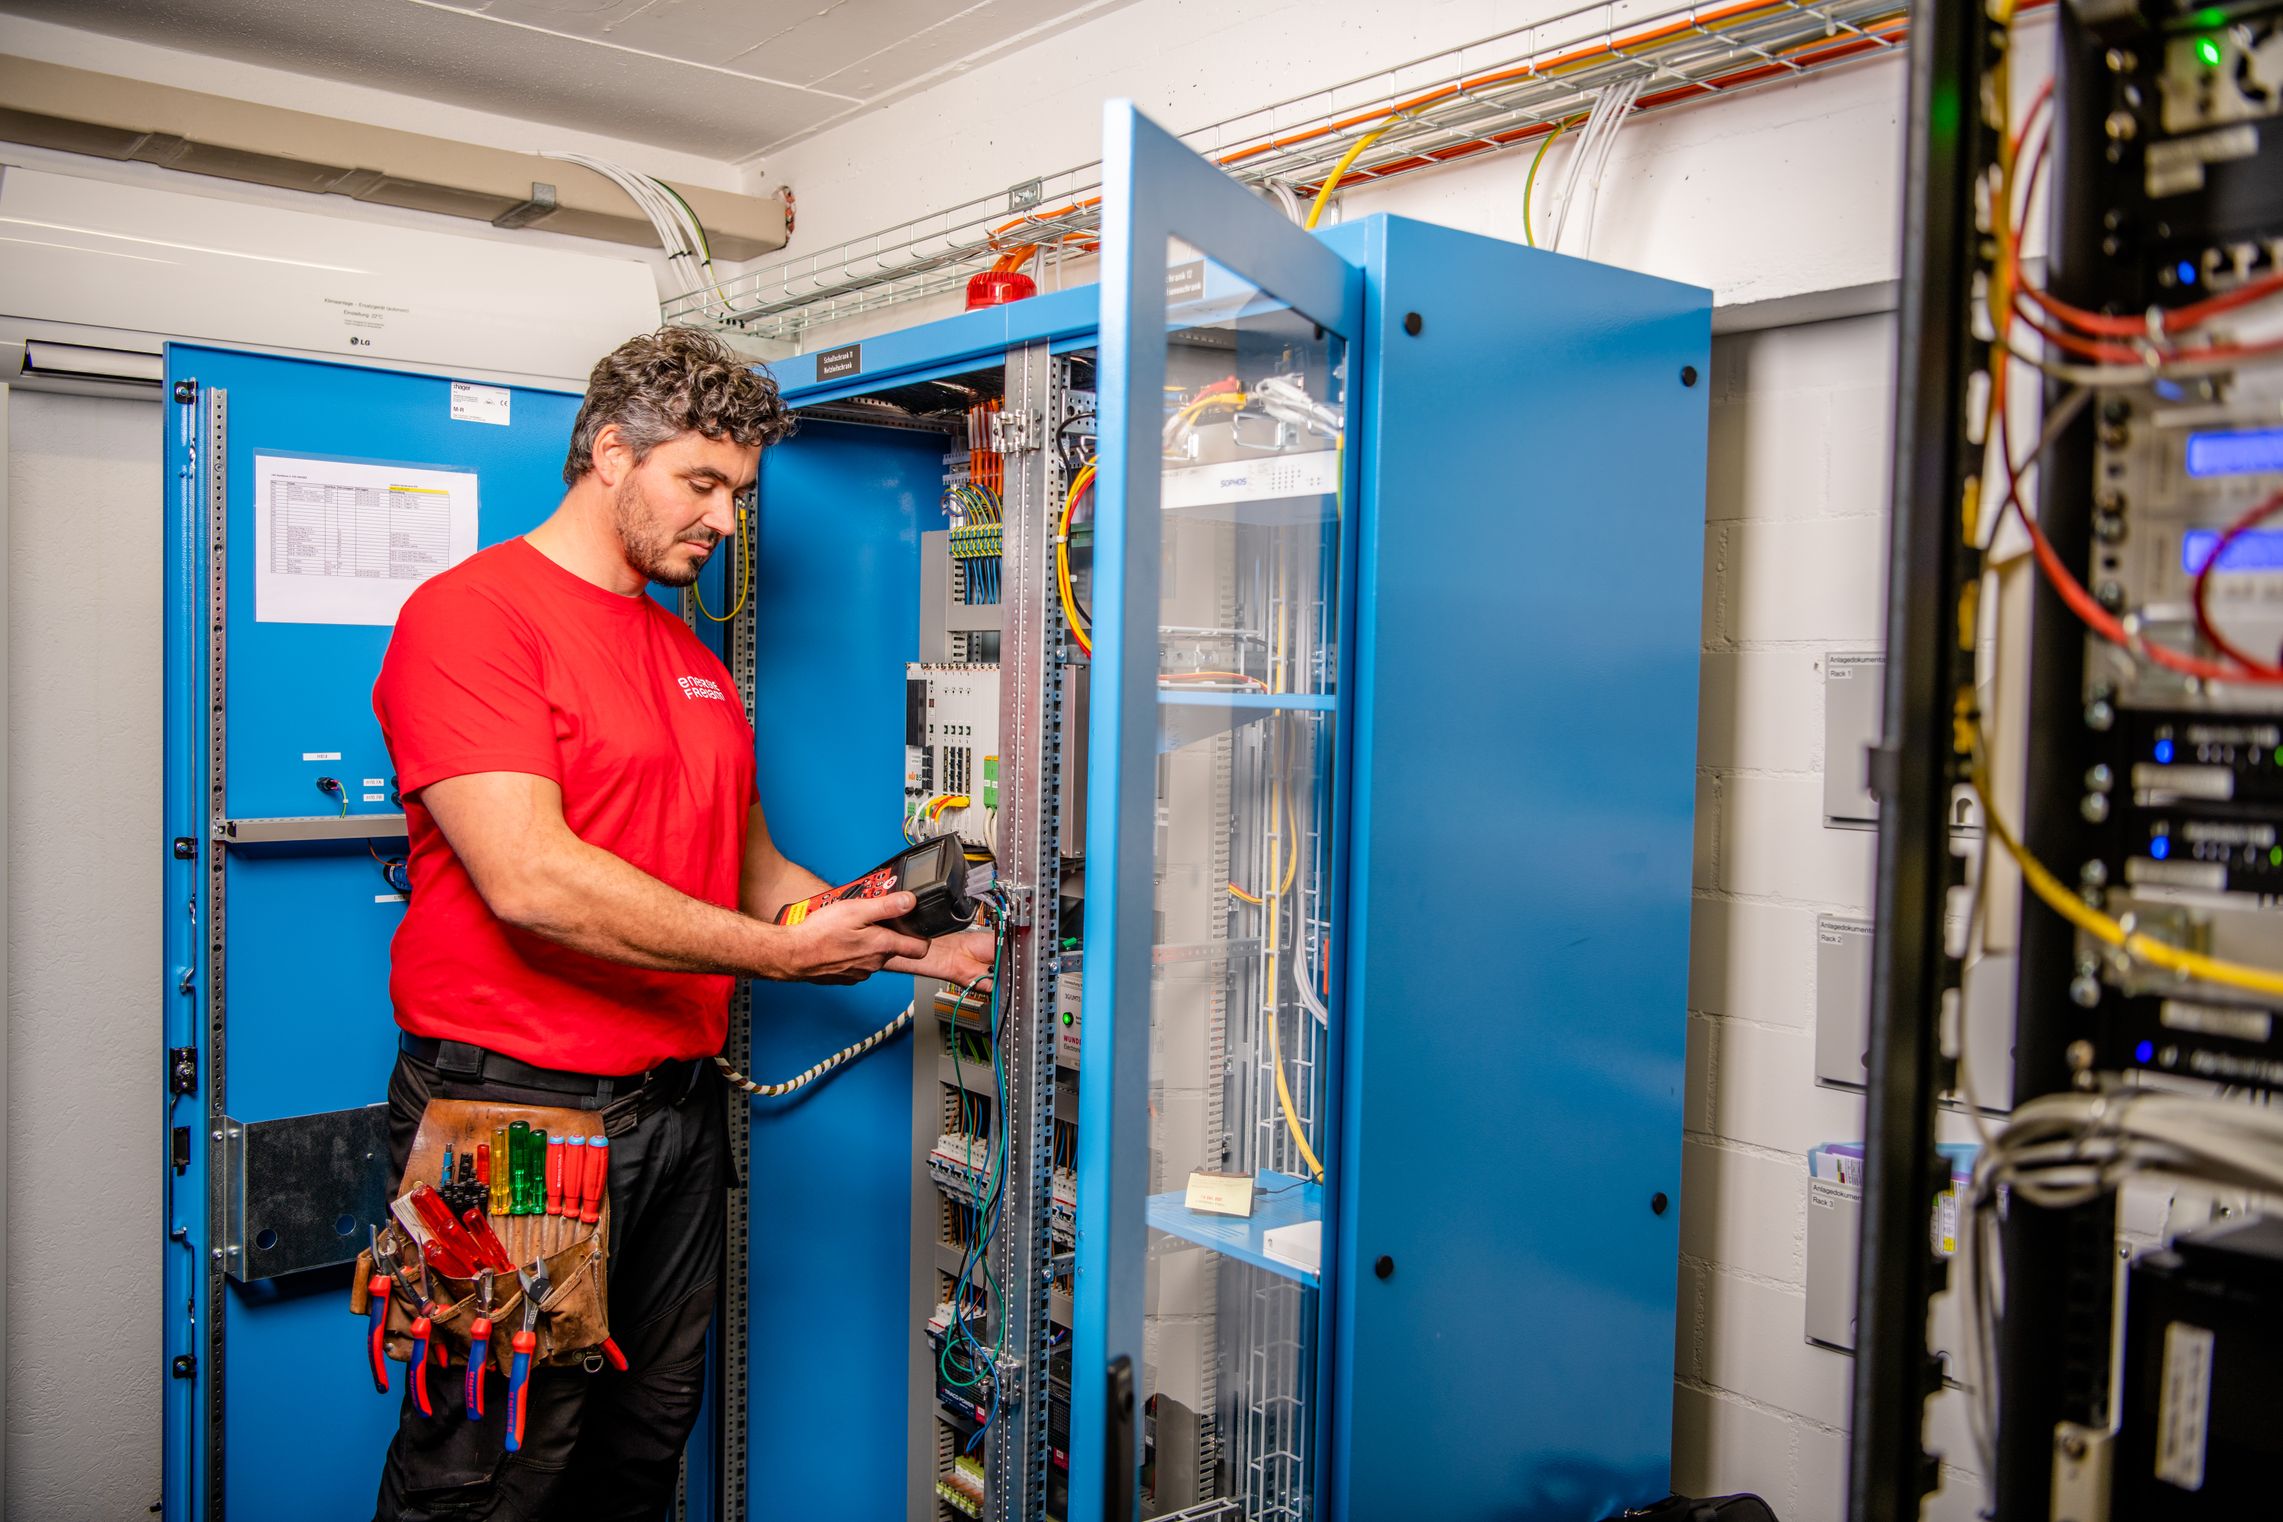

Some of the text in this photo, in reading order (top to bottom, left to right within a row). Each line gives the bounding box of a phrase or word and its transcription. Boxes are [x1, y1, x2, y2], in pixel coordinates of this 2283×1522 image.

[1220, 477, 1247, 488] SOPHOS
[1821, 934, 1835, 942] Rack
[1812, 1196, 1828, 1206] Rack
